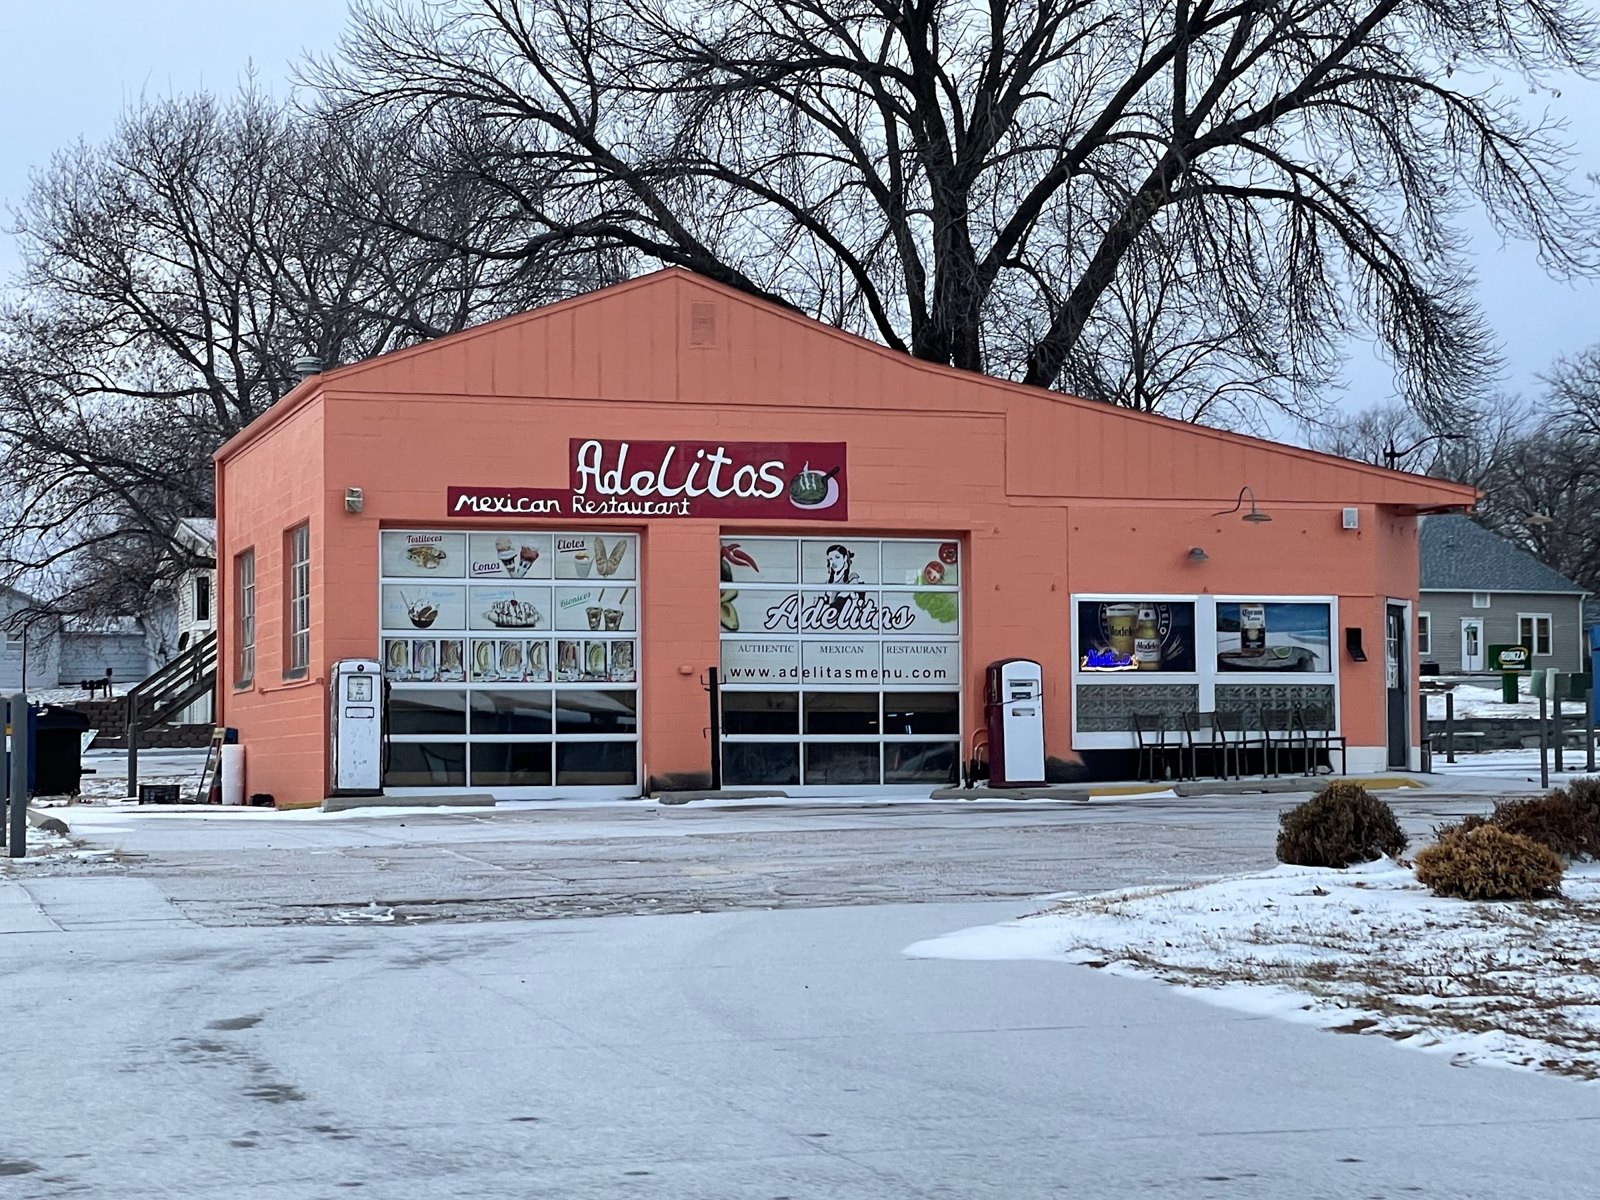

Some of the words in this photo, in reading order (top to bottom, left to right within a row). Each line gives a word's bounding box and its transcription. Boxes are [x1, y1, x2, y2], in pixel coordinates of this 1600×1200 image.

[454, 493, 562, 513] Mexican
[572, 495, 691, 515] Restaurant
[557, 539, 585, 550] Elotes
[472, 561, 501, 572] Conos
[764, 593, 915, 630] Adelitas
[737, 645, 795, 654] AUTHENTIC
[819, 645, 865, 654] MEXICAN
[886, 646, 949, 655] RESTAURANT
[730, 666, 947, 678] www.adelitasmenu.com
